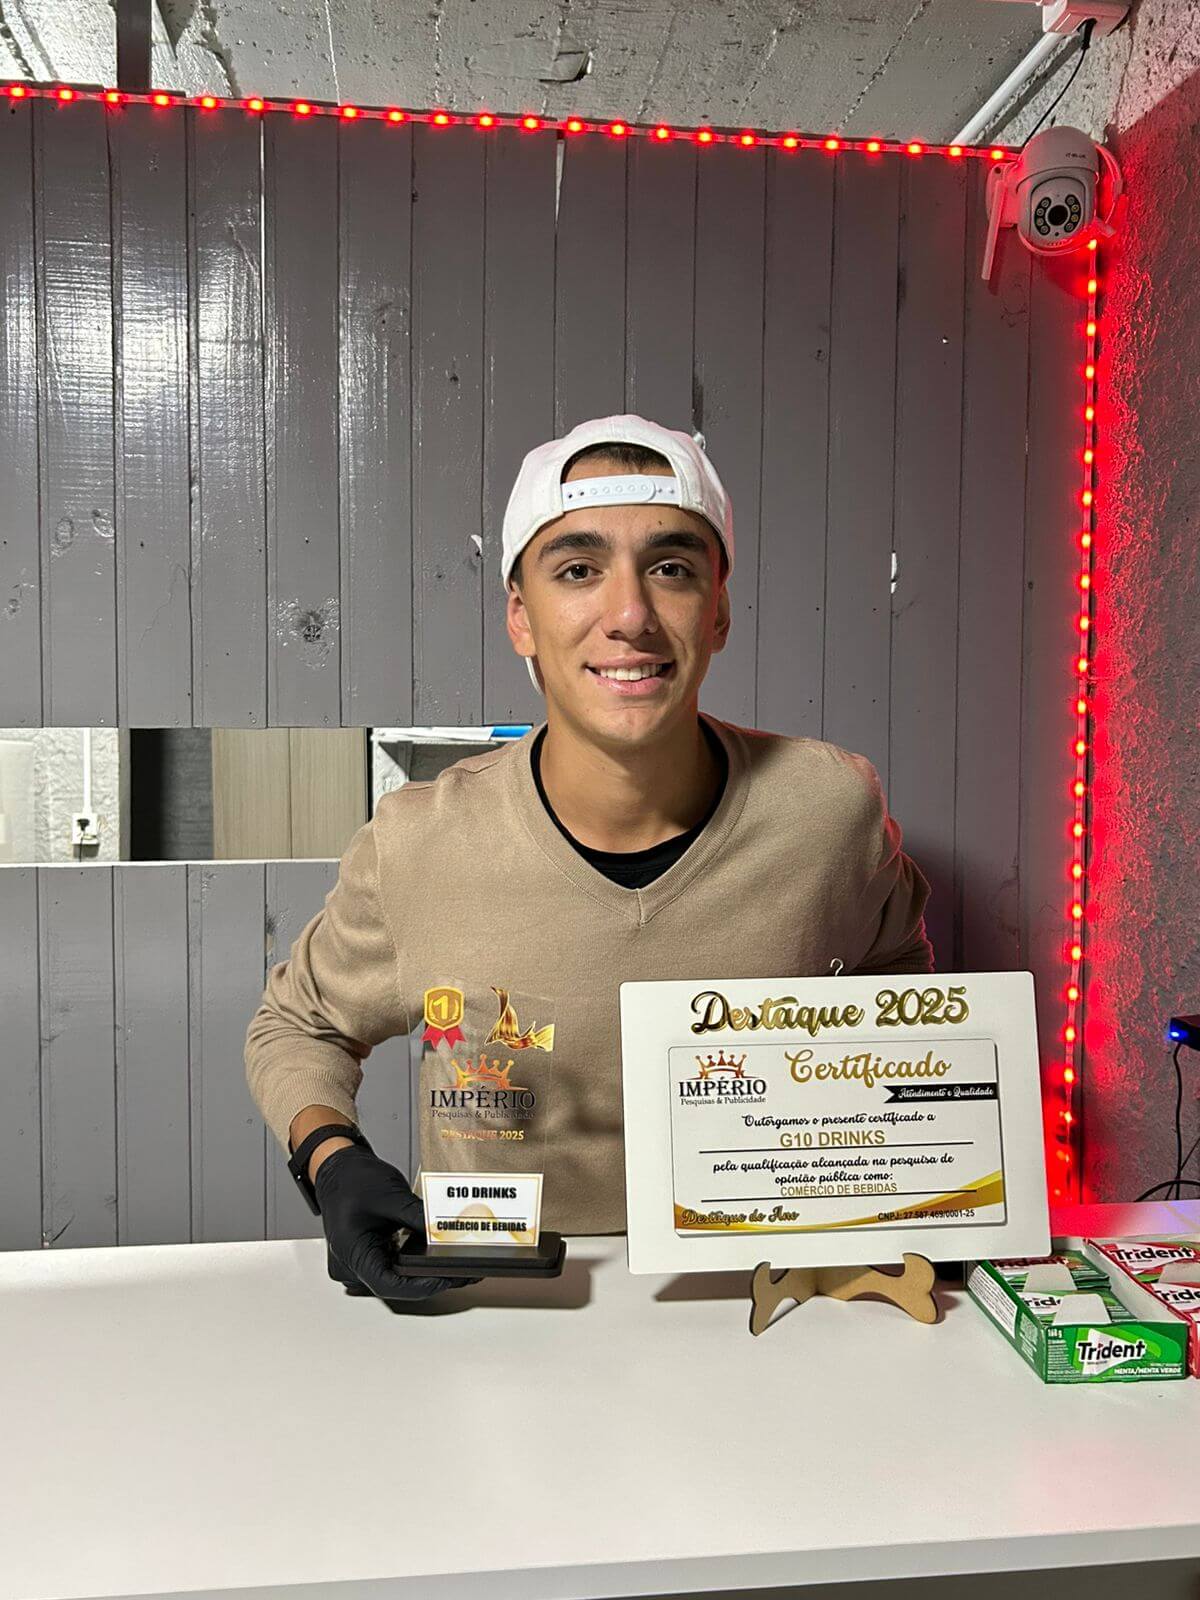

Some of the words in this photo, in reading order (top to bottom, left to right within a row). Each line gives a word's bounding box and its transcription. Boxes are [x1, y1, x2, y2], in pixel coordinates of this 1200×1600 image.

[690, 990, 865, 1038] Destaque
[875, 986, 970, 1028] 2025
[784, 1049, 952, 1088] Certificado
[678, 1076, 767, 1097] IMPÉRIO
[898, 1087, 947, 1098] Atendimento
[953, 1086, 994, 1098] Qualidade
[430, 1086, 536, 1109] IMPÉRIO
[680, 1098, 715, 1106] Pesquisas
[724, 1096, 767, 1104] Publicidade
[431, 1109, 473, 1120] Pesquisas
[474, 1110, 482, 1119] &
[741, 1114, 811, 1129] Outorgamos
[821, 1112, 868, 1127] presente
[868, 1110, 925, 1125] certificado
[926, 1113, 936, 1121] a
[499, 1129, 525, 1140] 2025
[779, 1131, 813, 1148] G10
[817, 1129, 886, 1147] DRINKS
[713, 1160, 739, 1174] pela
[740, 1158, 809, 1173] qualificação
[811, 1155, 869, 1168] alcançada
[872, 1158, 888, 1166] na
[890, 1154, 939, 1167] pesquisa
[940, 1152, 955, 1164] de
[774, 1173, 816, 1186] opinião
[818, 1170, 861, 1185] pública
[863, 1172, 893, 1181] como:
[446, 1186, 469, 1199] G10
[471, 1186, 517, 1199] DRINKS
[780, 1183, 835, 1197] COMÉRCIO
[836, 1184, 851, 1194] DE
[853, 1182, 898, 1194] BEBIDAS
[681, 1208, 747, 1226] Destaque
[748, 1208, 767, 1222] do
[768, 1205, 800, 1223] Ano
[877, 1211, 903, 1221] CNPJ:
[436, 1219, 479, 1231] COMÉRCIO
[480, 1221, 492, 1231] DE
[493, 1222, 527, 1232] BEBIDAS
[1109, 1247, 1193, 1261] Trident
[1077, 1340, 1146, 1361] Trident
[1160, 1366, 1182, 1374] VERDE
